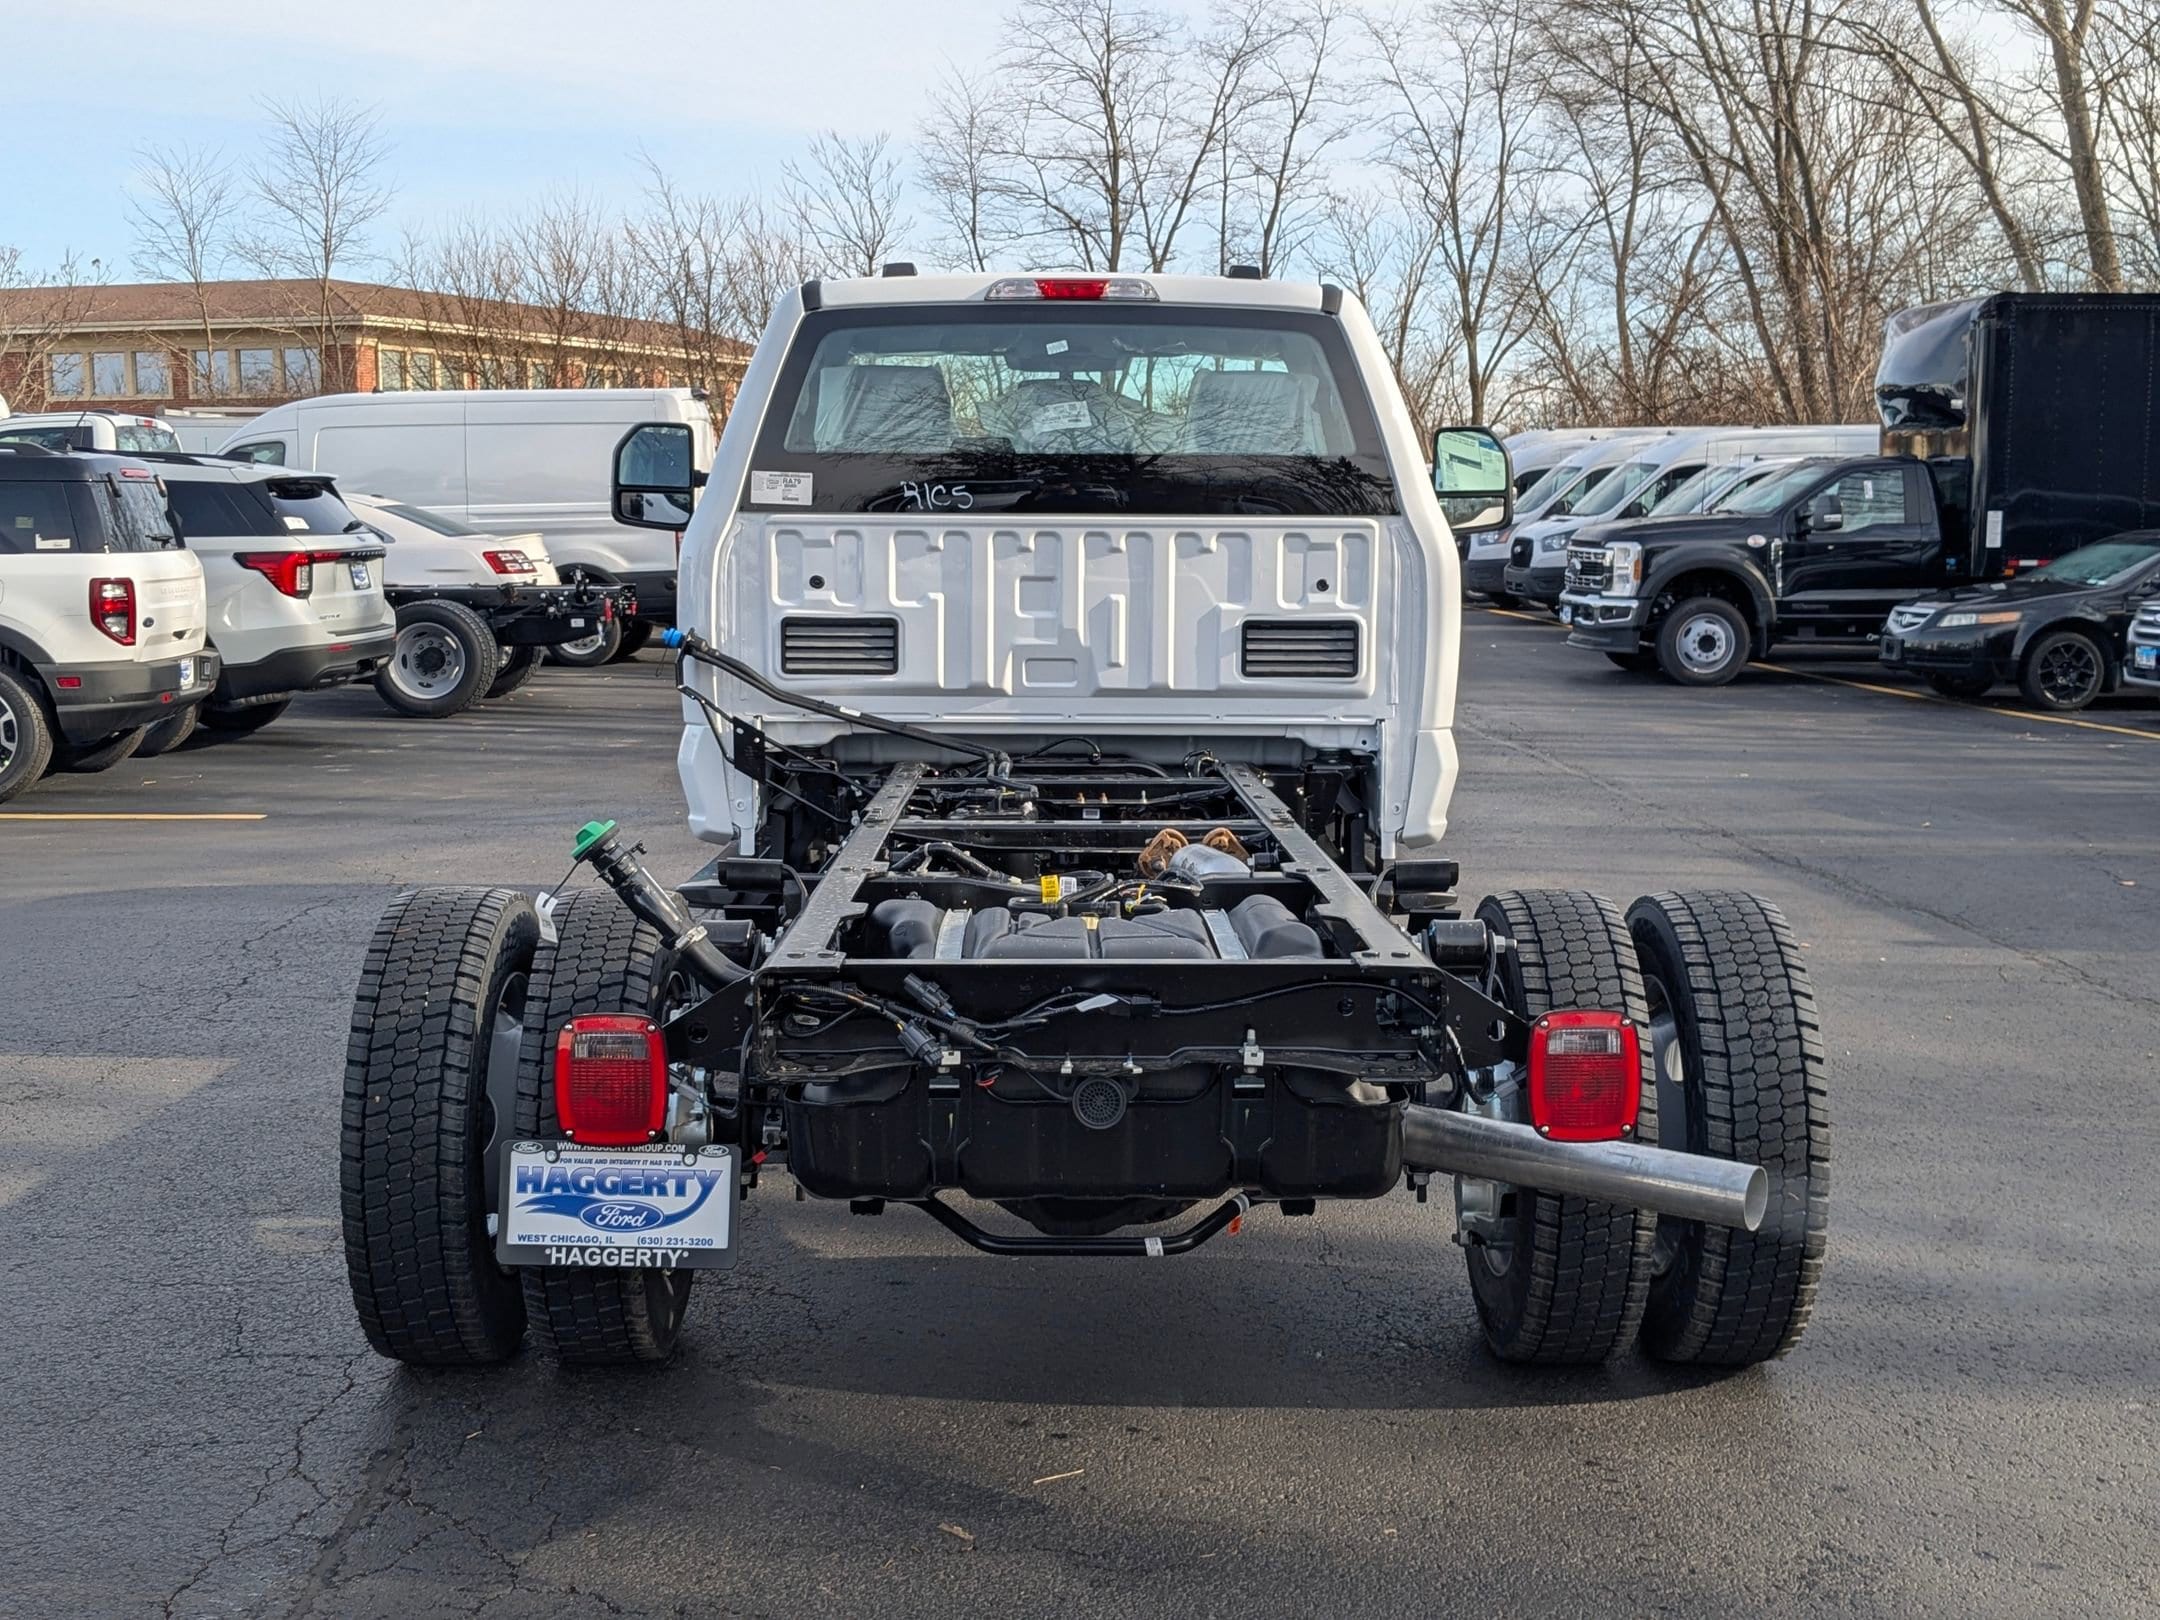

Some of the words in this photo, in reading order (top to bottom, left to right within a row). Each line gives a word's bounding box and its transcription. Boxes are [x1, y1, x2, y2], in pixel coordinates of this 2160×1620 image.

[609, 1158, 641, 1166] INTEGRITY
[516, 1165, 724, 1198] HAGGERTY
[595, 1203, 647, 1228] Ford
[517, 1233, 548, 1243] WEST
[550, 1234, 602, 1245] CHICAGO,
[605, 1235, 616, 1245] IL
[636, 1235, 663, 1247] (630)
[666, 1236, 714, 1247] 231-3200
